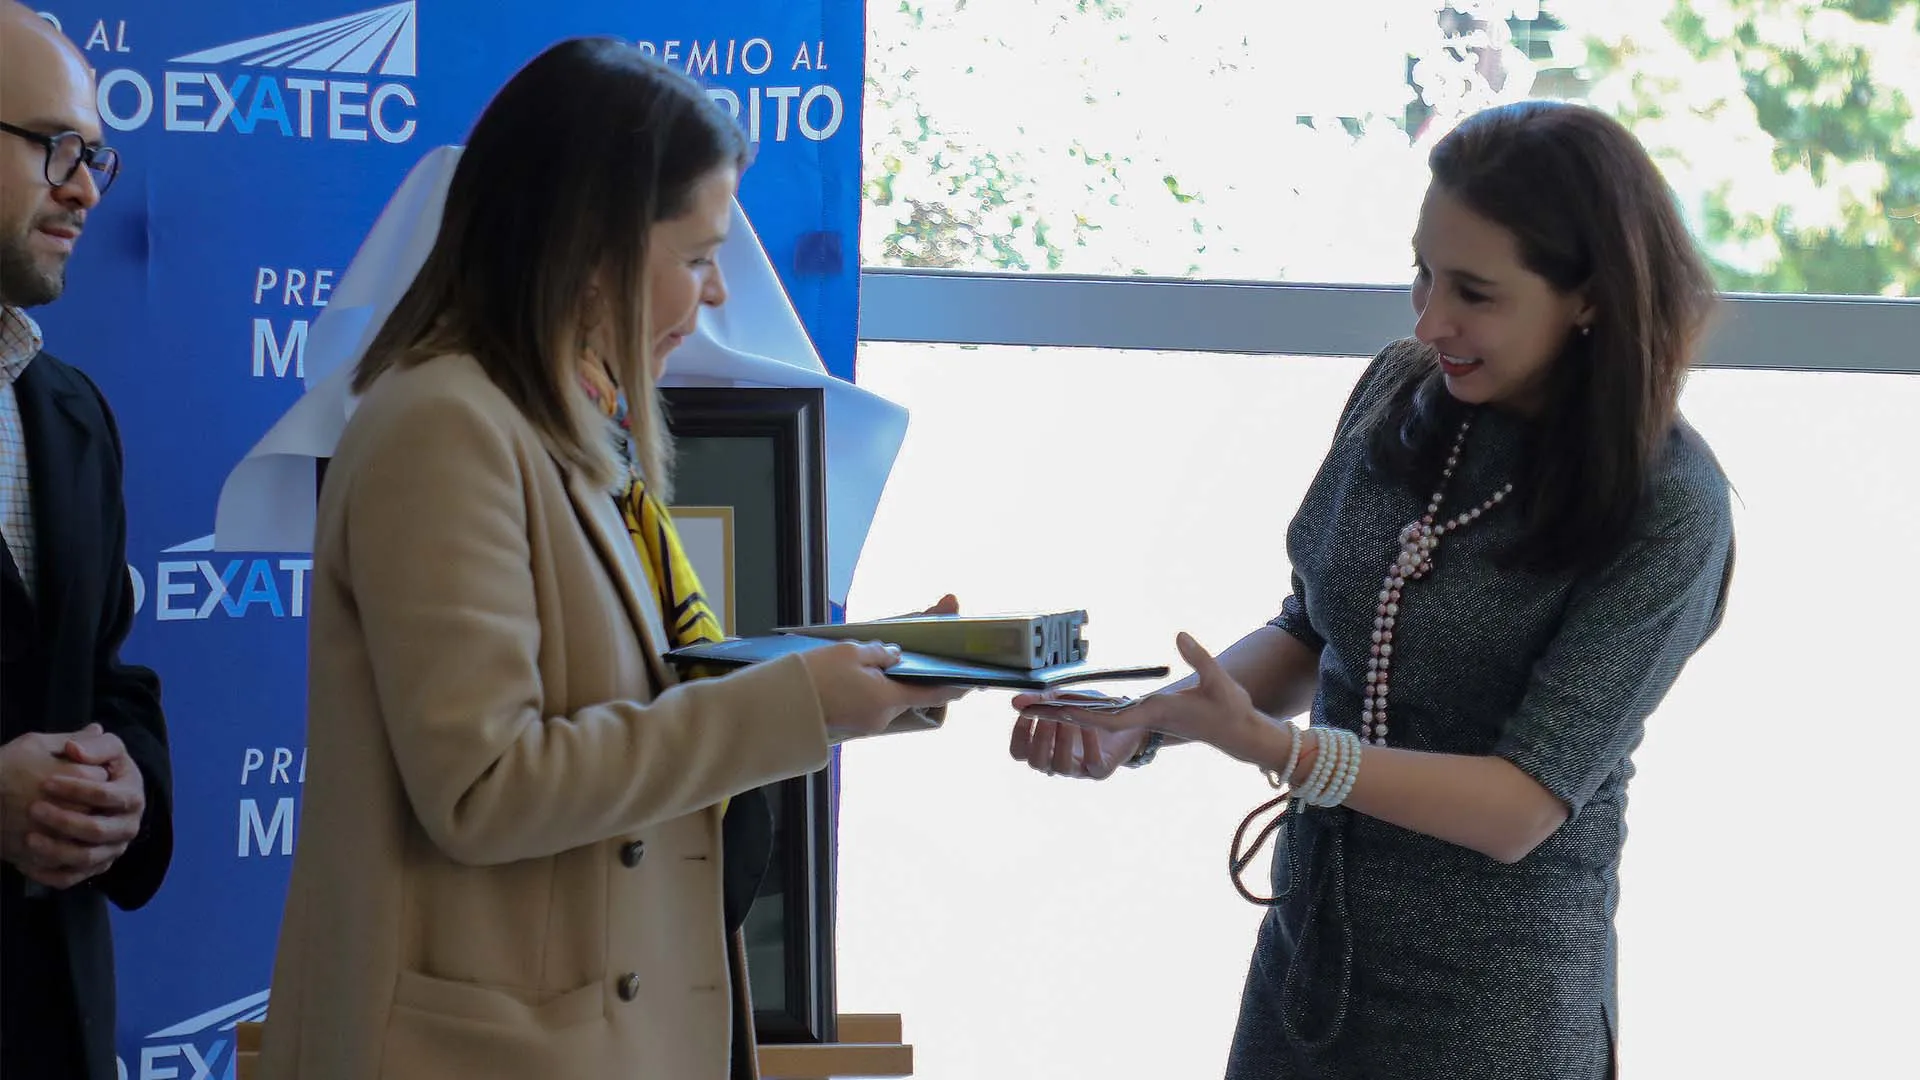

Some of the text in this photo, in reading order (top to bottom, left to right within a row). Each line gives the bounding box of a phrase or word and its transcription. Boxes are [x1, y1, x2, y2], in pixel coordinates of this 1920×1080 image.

[85, 19, 130, 52] AL
[792, 40, 828, 71] AL
[95, 68, 417, 143] O EXATEC
[254, 267, 333, 306] PRE
[156, 559, 314, 621] EXAT
[140, 1039, 236, 1080] EX
